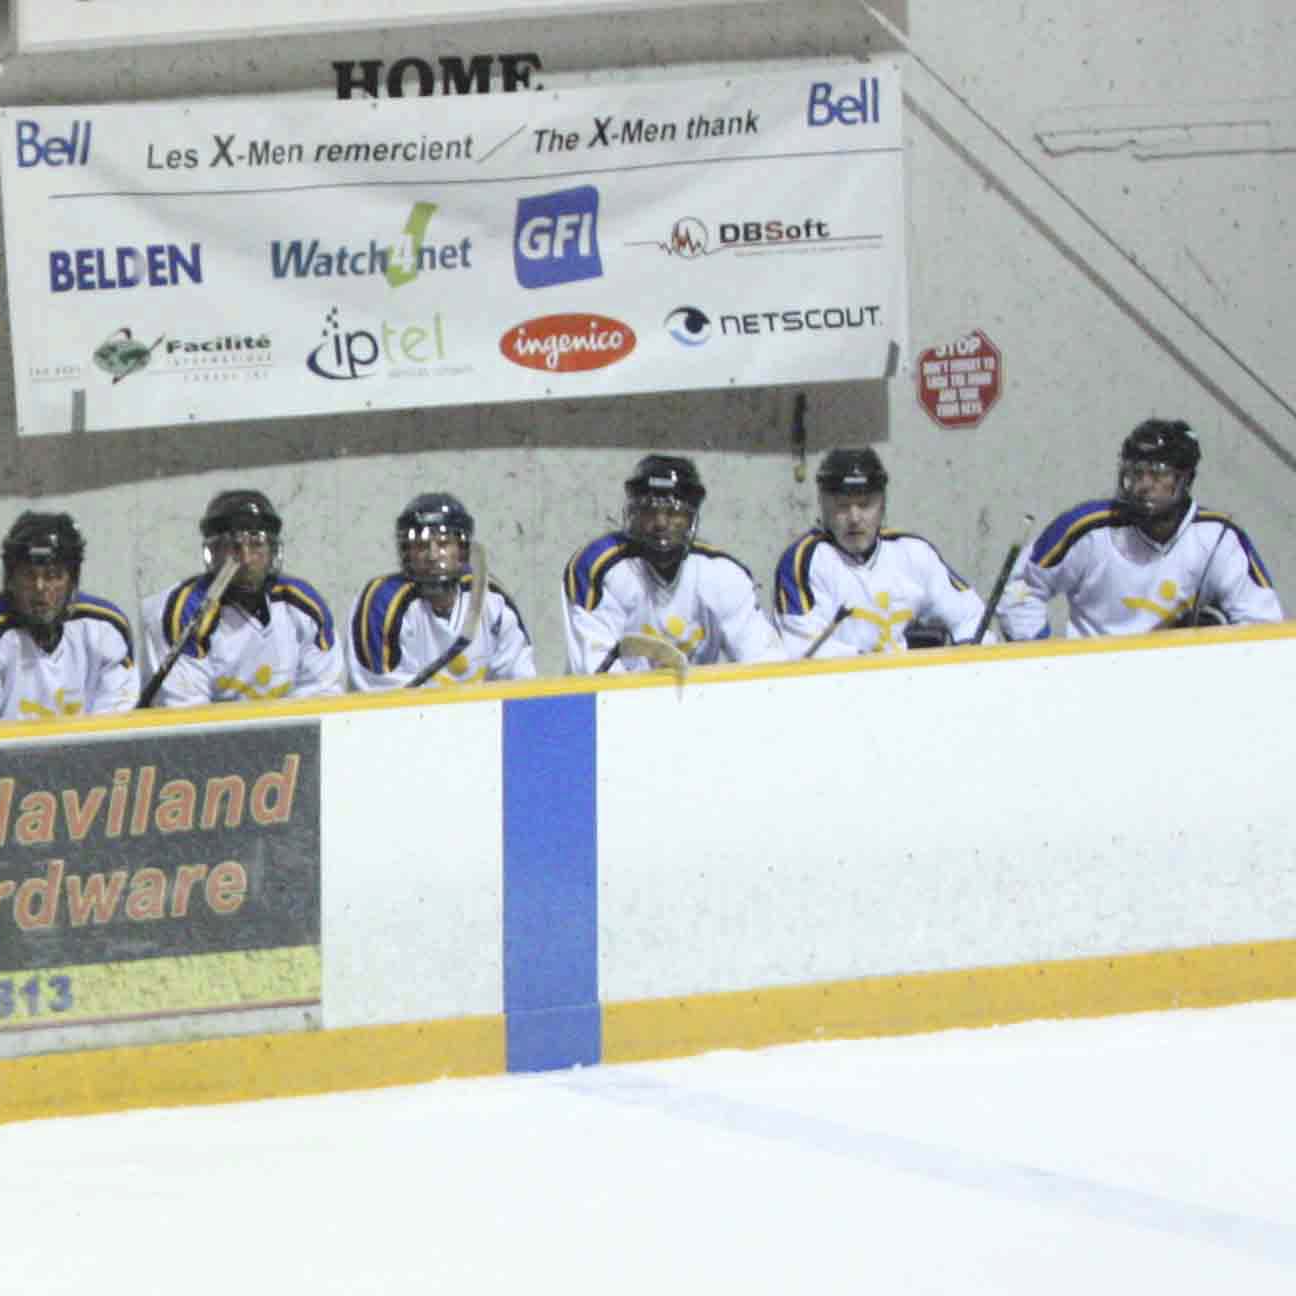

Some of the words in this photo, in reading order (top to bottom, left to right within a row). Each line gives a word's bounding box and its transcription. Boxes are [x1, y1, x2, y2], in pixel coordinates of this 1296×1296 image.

[331, 53, 544, 101] HOME
[807, 77, 881, 127] Bell
[15, 119, 93, 168] Bell
[147, 142, 199, 169] Les
[210, 135, 304, 168] X-Men
[313, 135, 474, 163] remercient
[533, 129, 579, 153] The
[587, 116, 676, 148] X-Men
[686, 109, 760, 140] thank
[519, 212, 592, 260] GFI
[719, 218, 831, 243] DBSoft
[48, 243, 203, 292] BELDEN
[513, 319, 624, 368] ingenico
